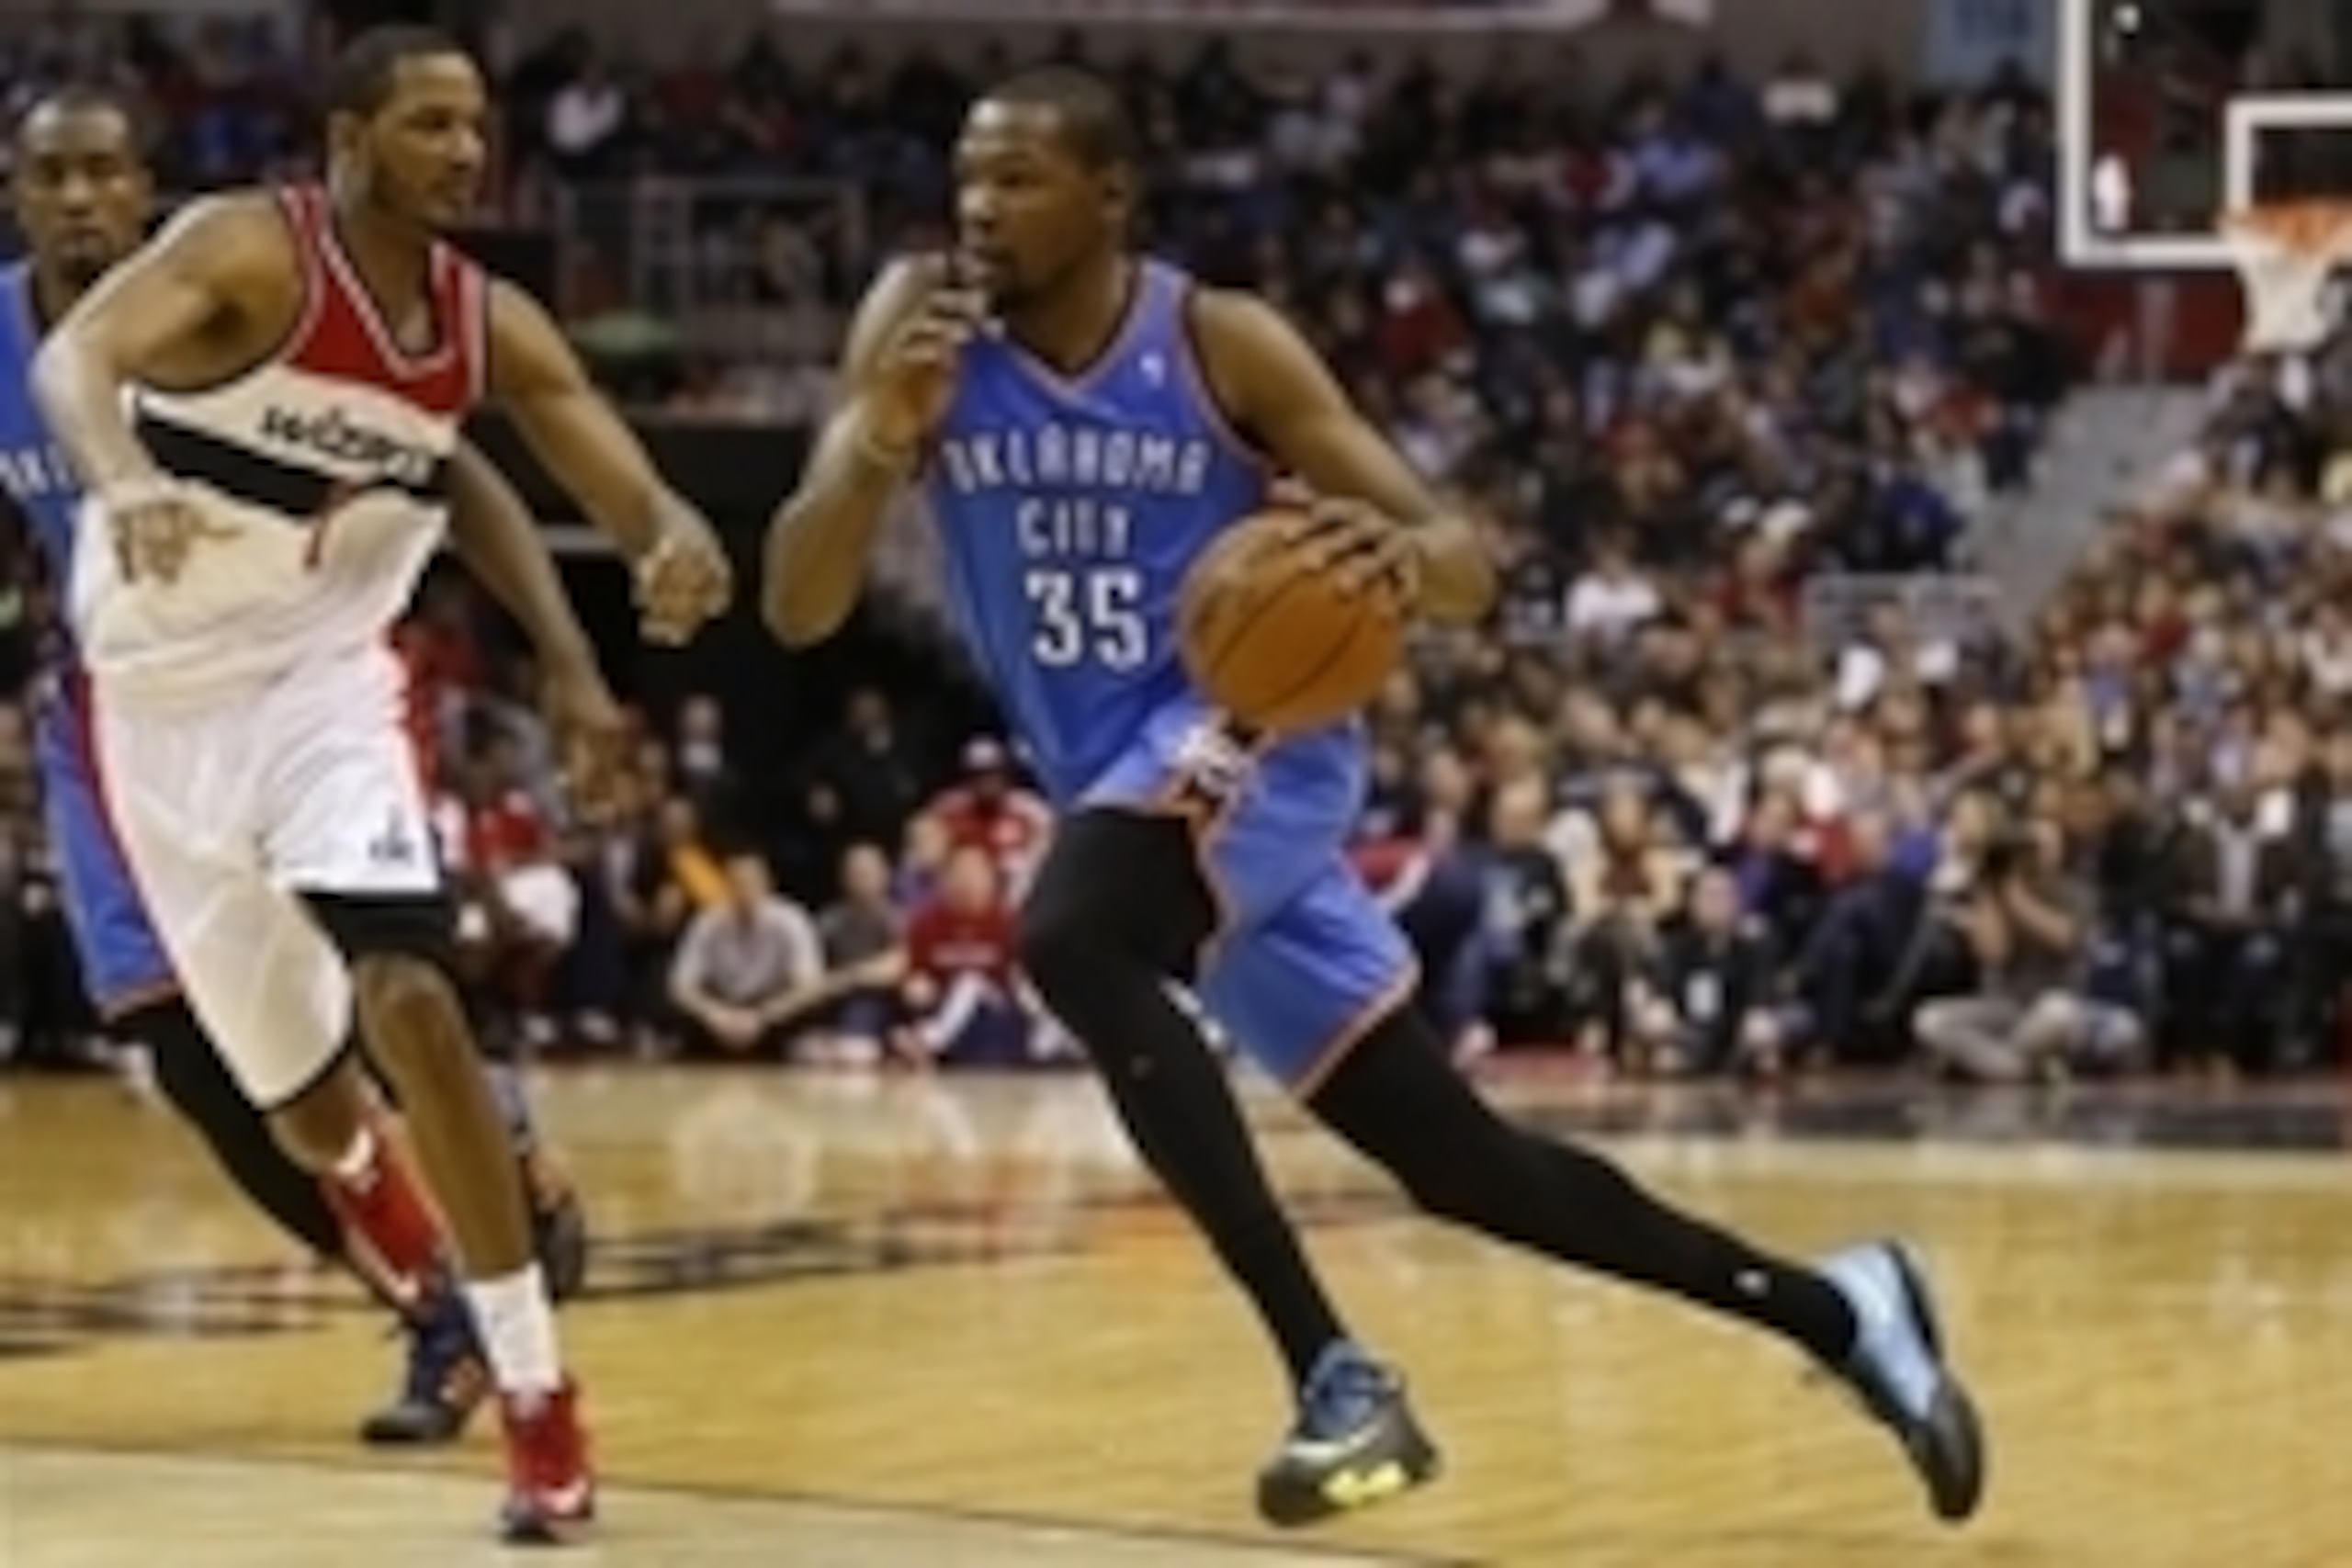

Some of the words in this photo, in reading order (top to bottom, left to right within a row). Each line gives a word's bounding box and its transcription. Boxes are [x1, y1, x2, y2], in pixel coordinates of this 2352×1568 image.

[942, 422, 1209, 494] OKLAHOMA
[1017, 498, 1130, 557] CITY
[1023, 568, 1149, 672] 35
